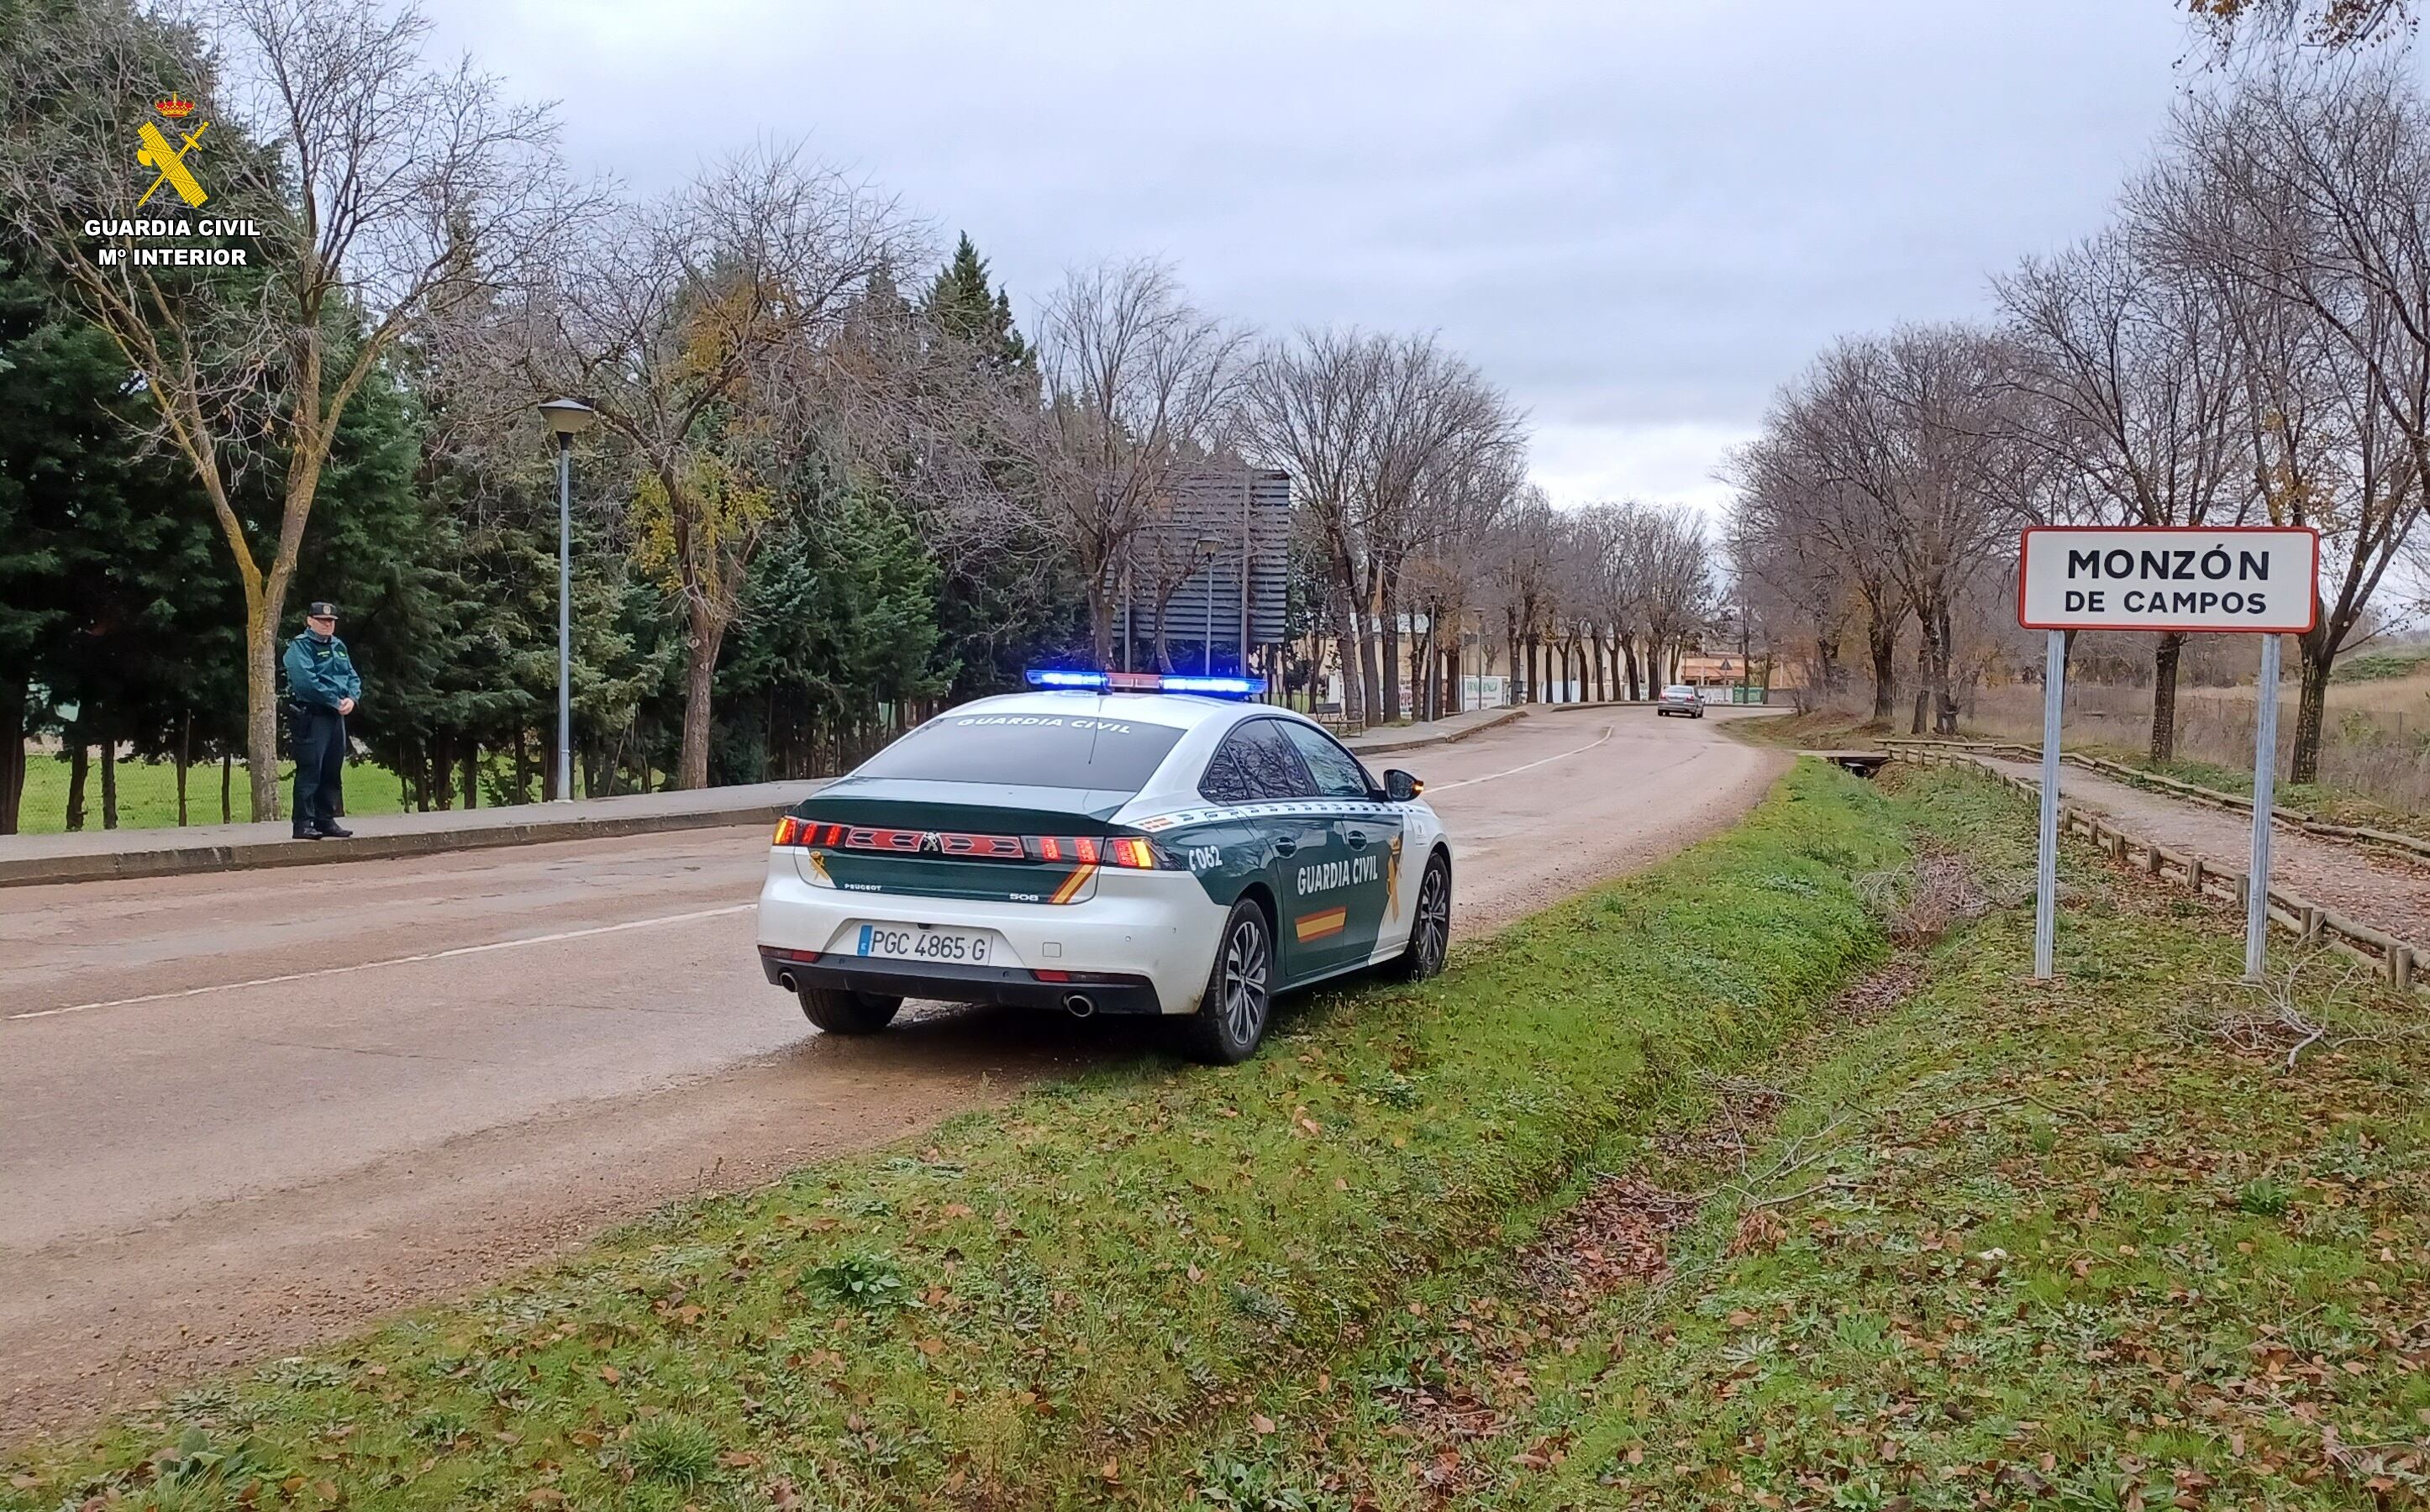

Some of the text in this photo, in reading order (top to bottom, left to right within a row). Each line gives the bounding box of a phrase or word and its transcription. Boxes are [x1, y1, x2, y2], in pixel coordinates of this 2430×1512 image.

[2067, 543, 2270, 580] MONZÓN
[2065, 591, 2267, 615] DE CAMPOS
[957, 717, 1130, 734] GUARDIA CIVIL
[844, 883, 882, 891] PEUGEOT
[1297, 855, 1378, 896] GUARDIA CIVIL
[1009, 893, 1039, 901] 508
[870, 931, 986, 961] PGC 4865 G
